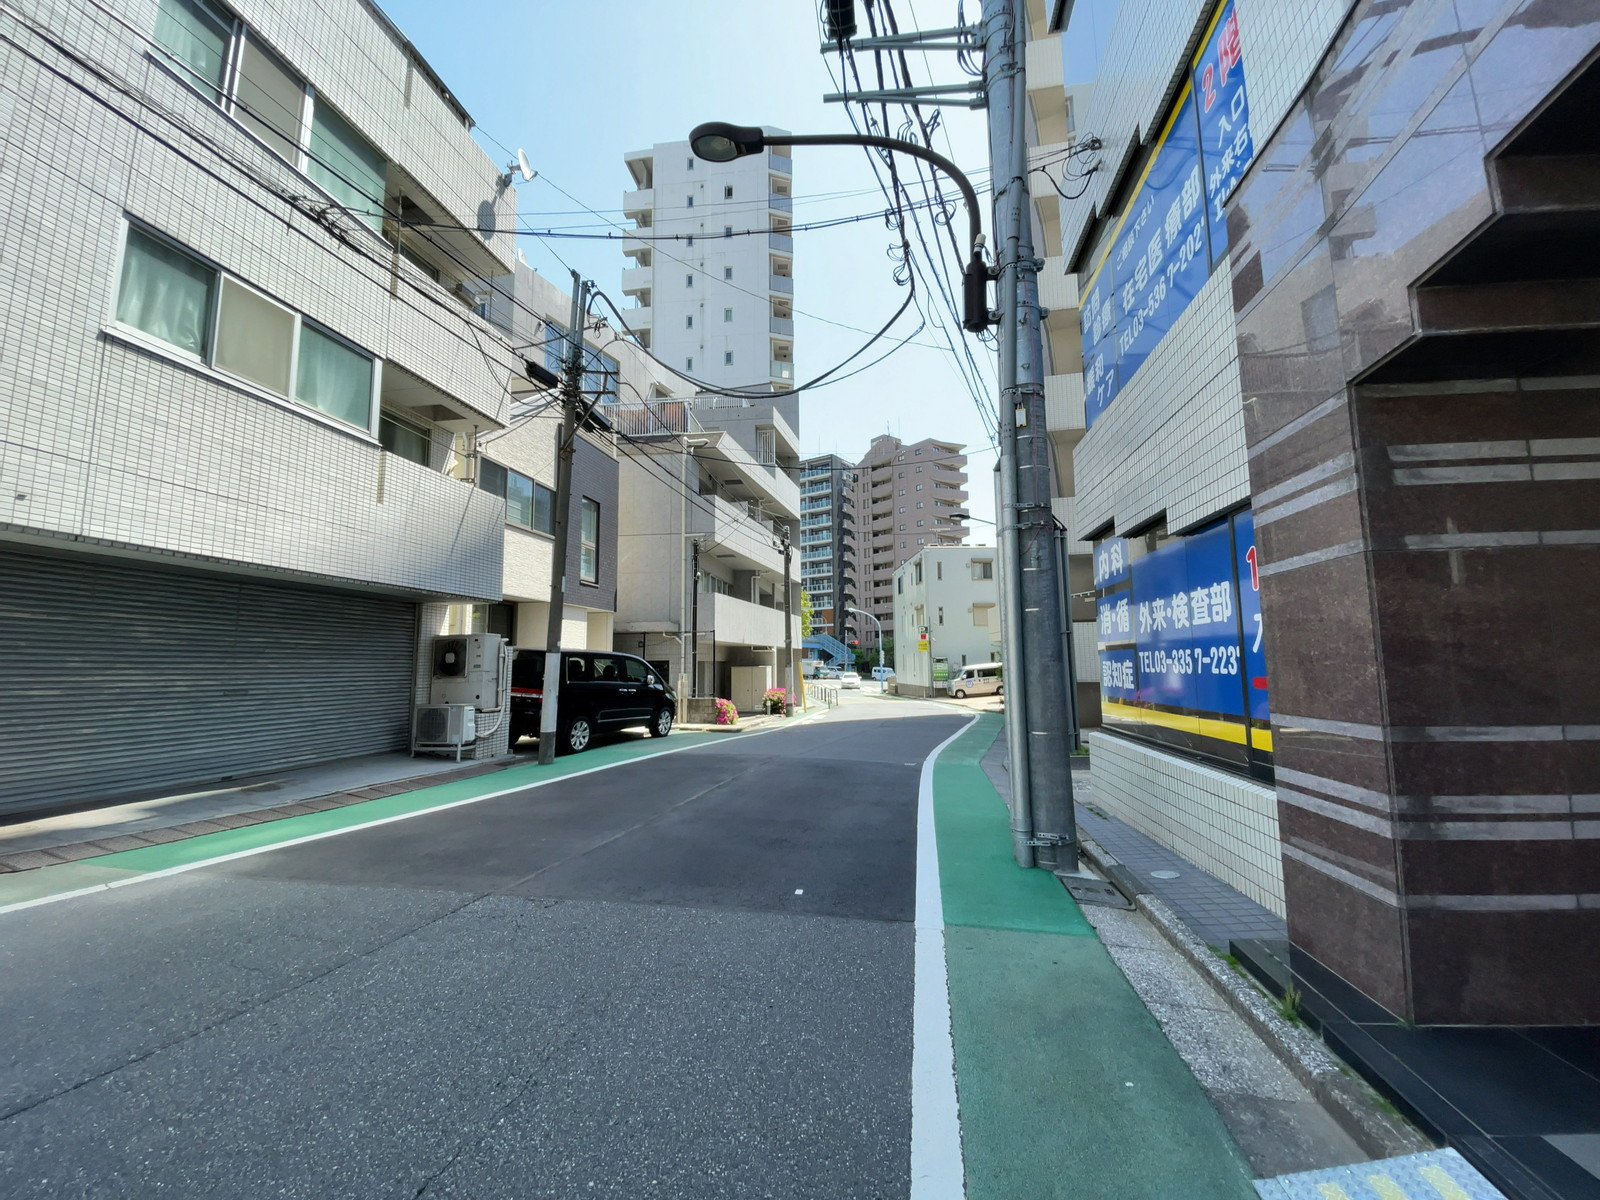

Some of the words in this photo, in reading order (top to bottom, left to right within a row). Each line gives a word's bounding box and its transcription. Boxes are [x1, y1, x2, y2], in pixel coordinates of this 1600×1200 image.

[1218, 84, 1245, 149] 入口
[1209, 123, 1248, 199] 外来右
[1122, 164, 1201, 315] 在宅医療部
[1083, 286, 1101, 336] 訪問
[1119, 220, 1205, 357] TEL03-5367-202
[1093, 295, 1112, 347] 診療
[1086, 352, 1104, 397] 緩和
[1096, 367, 1115, 409] ケア
[1099, 542, 1123, 581] 内科
[1100, 598, 1129, 635] 消・循
[1140, 581, 1231, 634] 外来・検査部
[1103, 660, 1134, 690] 認知症
[1139, 645, 1240, 675] TEL03-3357-223
